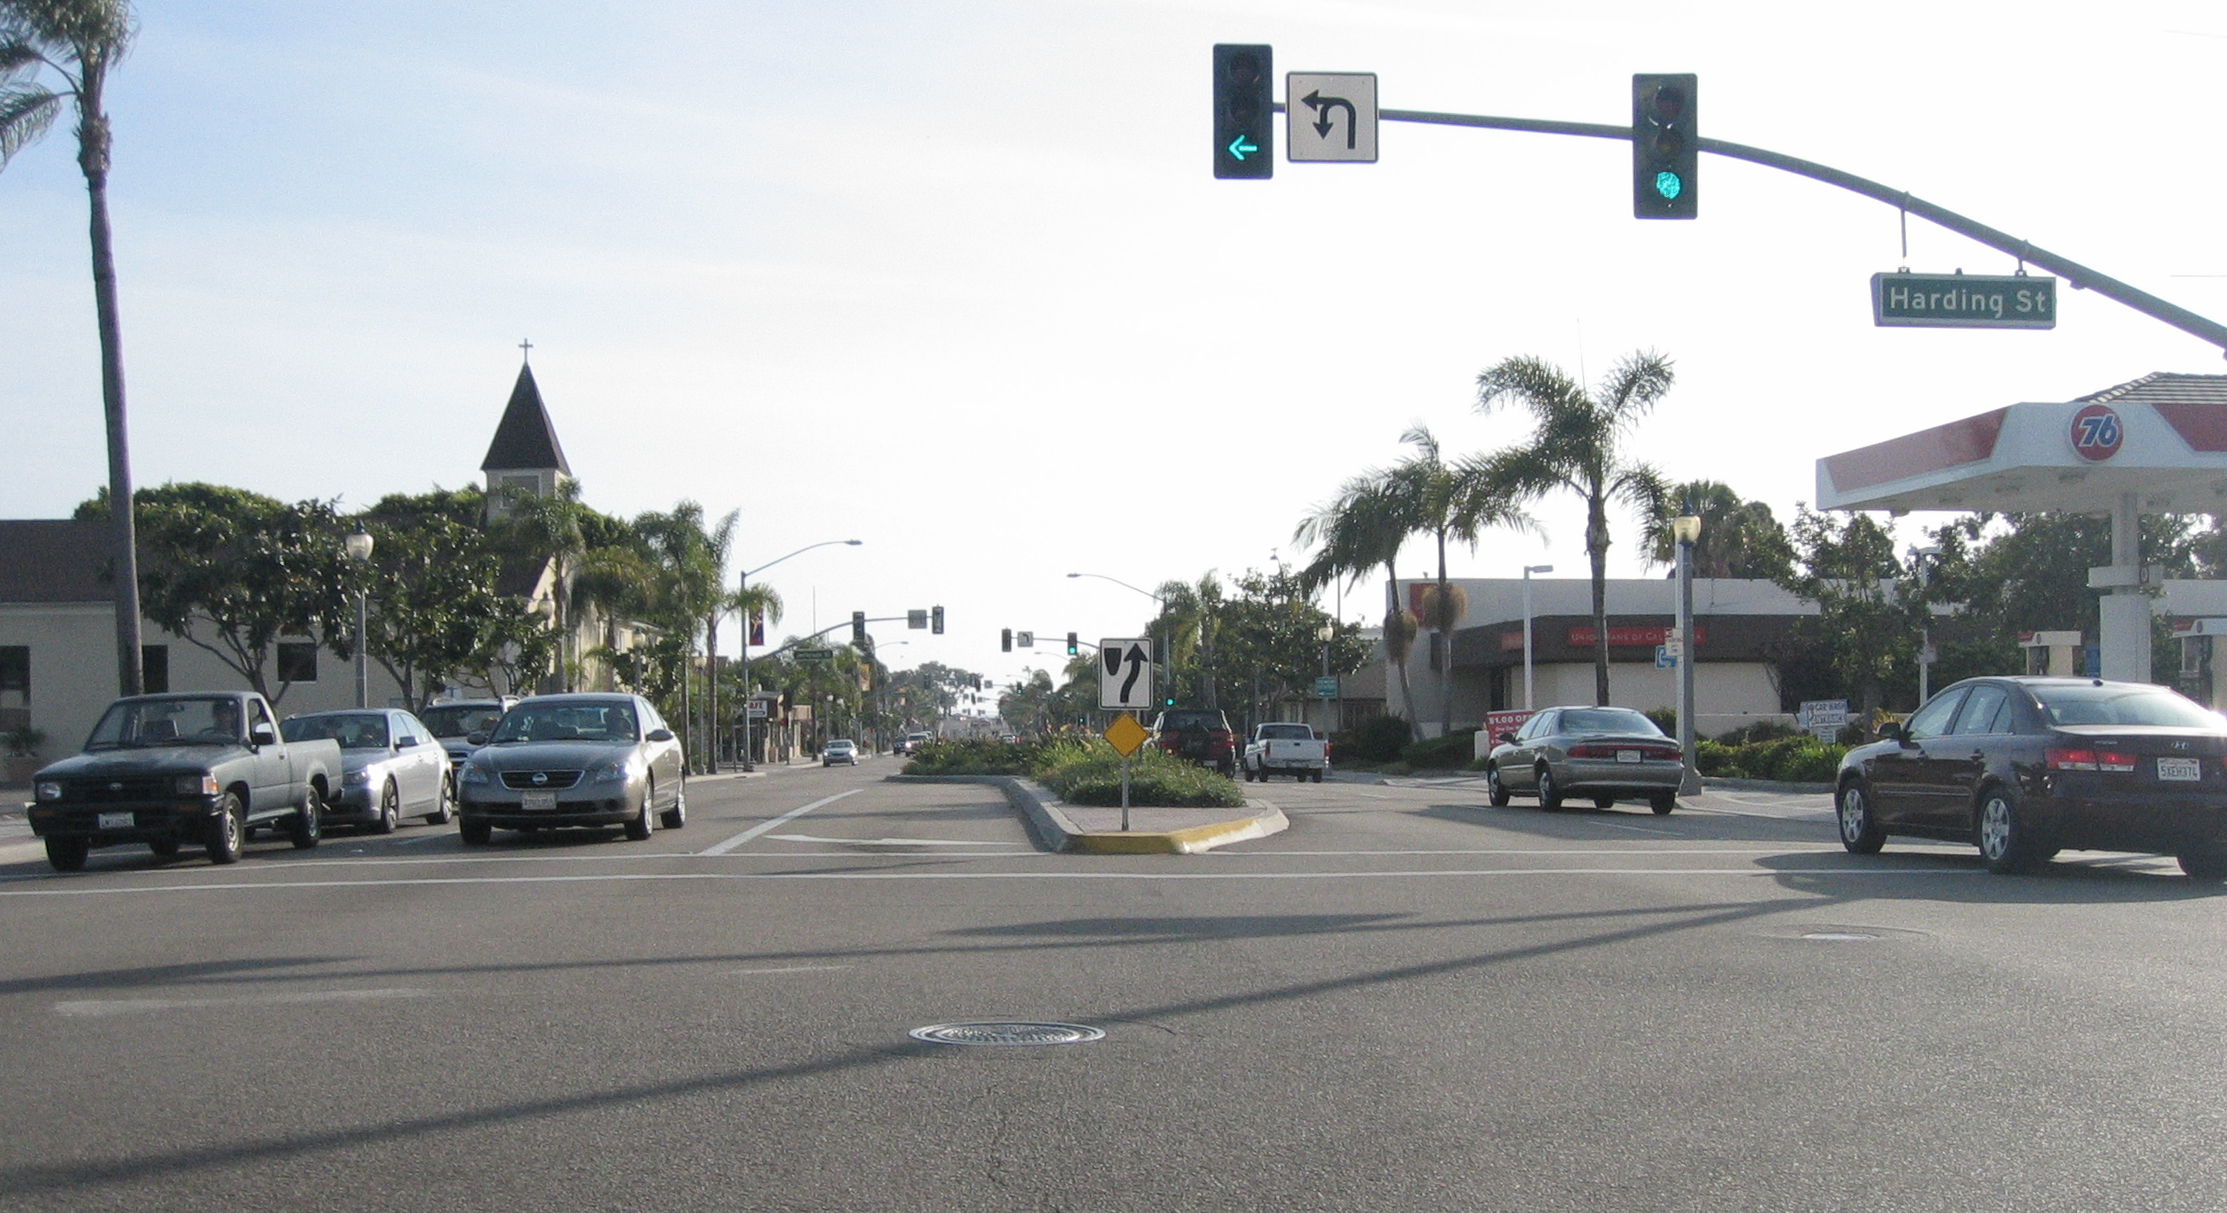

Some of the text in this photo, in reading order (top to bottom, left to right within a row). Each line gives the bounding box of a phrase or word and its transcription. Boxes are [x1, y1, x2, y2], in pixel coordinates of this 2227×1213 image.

[1890, 287, 2046, 319] Harding St
[2079, 413, 2119, 447] 76
